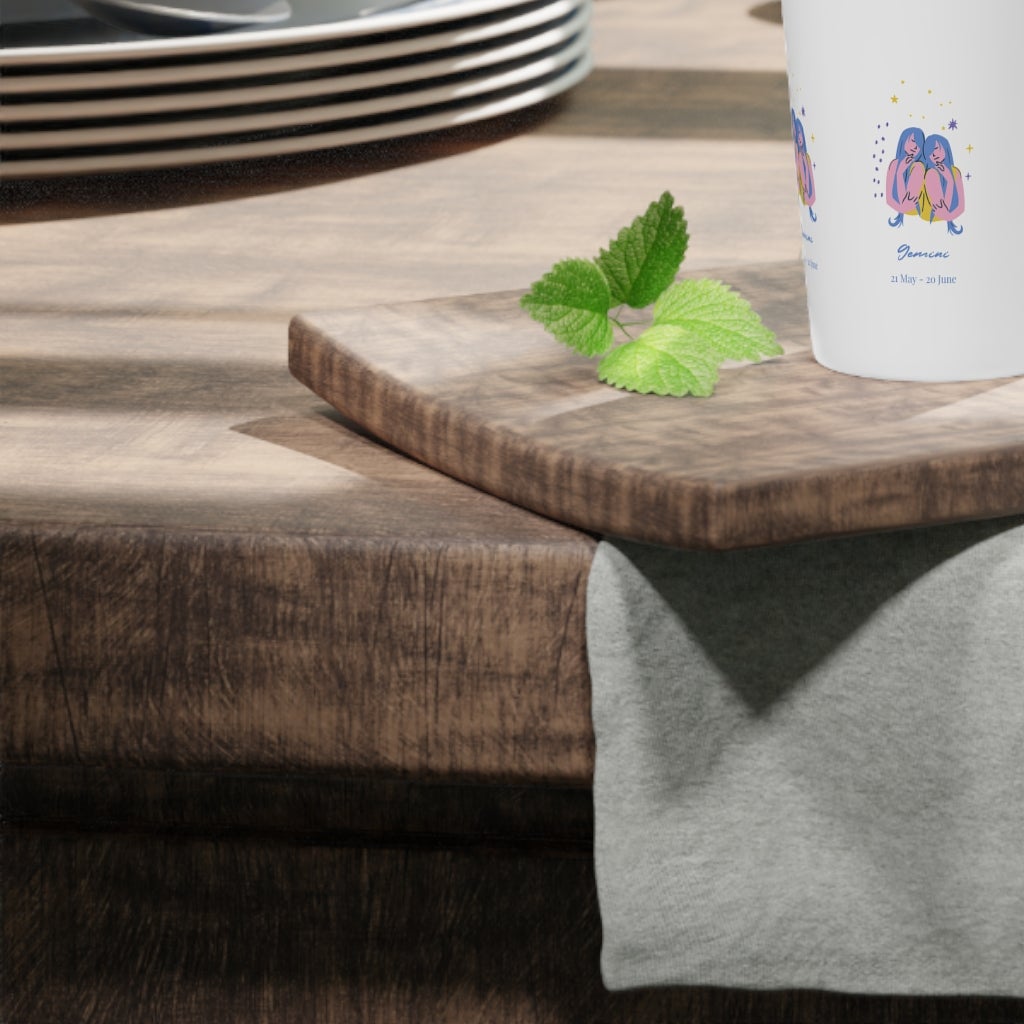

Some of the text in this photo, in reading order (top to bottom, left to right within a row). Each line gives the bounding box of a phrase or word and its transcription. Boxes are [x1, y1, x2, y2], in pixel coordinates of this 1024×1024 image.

[897, 243, 950, 261] Gemini
[890, 275, 898, 283] 21
[900, 273, 917, 286] May
[926, 276, 935, 284] 20
[937, 274, 957, 286] June
